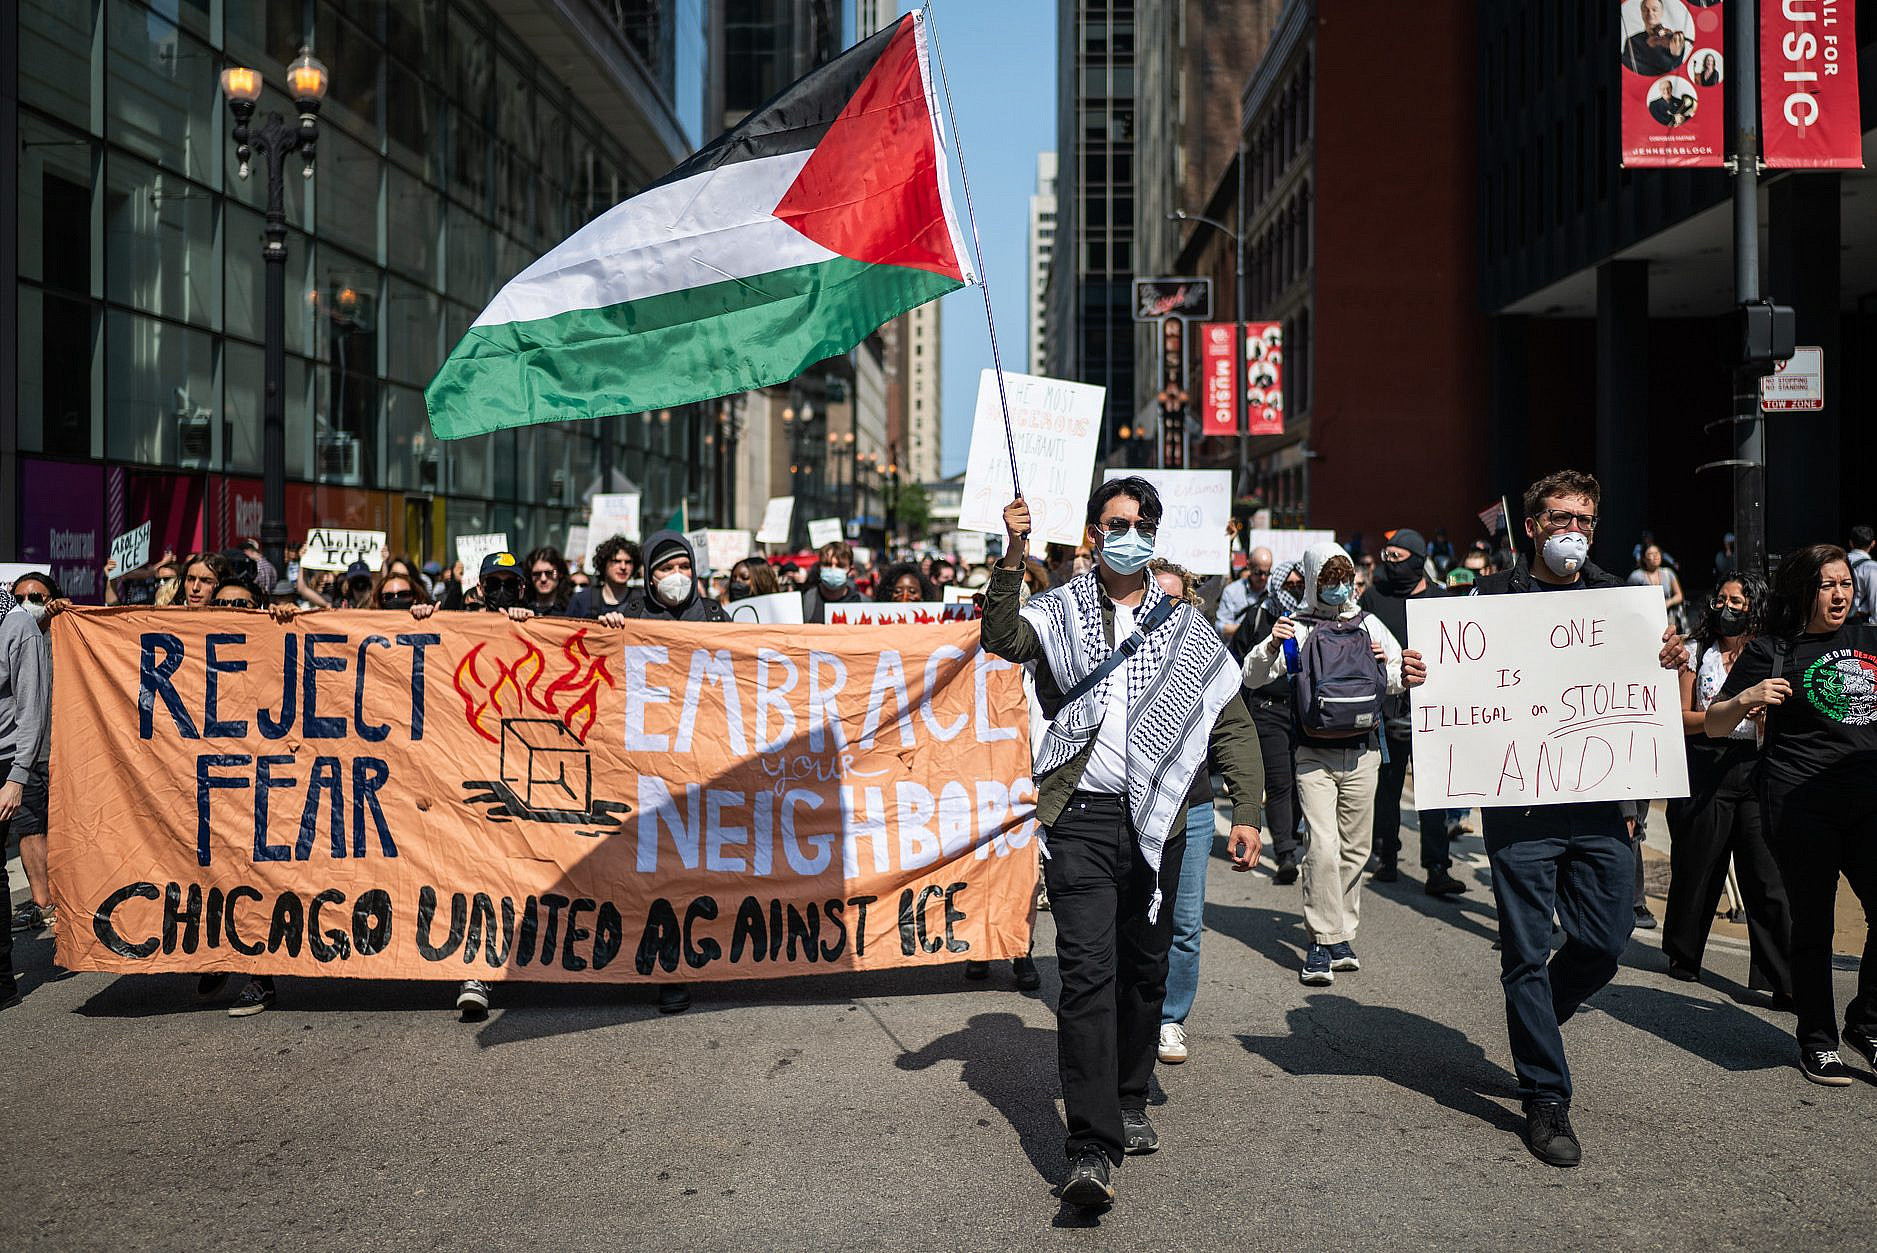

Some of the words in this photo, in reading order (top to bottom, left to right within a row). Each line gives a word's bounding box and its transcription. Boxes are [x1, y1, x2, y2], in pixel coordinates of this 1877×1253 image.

[1824, 35, 1838, 76] FOR
[1042, 384, 1081, 413] MOST
[1766, 400, 1787, 408] TOW
[1791, 400, 1817, 408] ZONE
[968, 486, 1075, 541] 192
[50, 528, 95, 560] Restaurant
[112, 523, 151, 556] ABOLISH
[309, 529, 378, 551] Abolish
[121, 549, 139, 572] ICE
[1438, 620, 1487, 664] NO
[1550, 618, 1607, 649] ONE
[1840, 648, 1852, 657] UN
[138, 632, 442, 743] REJECT
[624, 644, 1018, 757] EMBRACE
[1496, 668, 1521, 689] IS
[1418, 705, 1513, 733] ILLEGAL
[1531, 704, 1549, 717] on
[1559, 682, 1657, 723] STOLEN
[760, 751, 889, 798] your
[1446, 729, 1660, 798] LAND!!
[196, 754, 399, 867] FEAR
[636, 774, 1036, 879] NEIGHBORS
[92, 881, 393, 963] CHICAGO
[414, 885, 623, 972] UNITED
[635, 895, 878, 975] AGAINST
[898, 881, 970, 957] ICE
